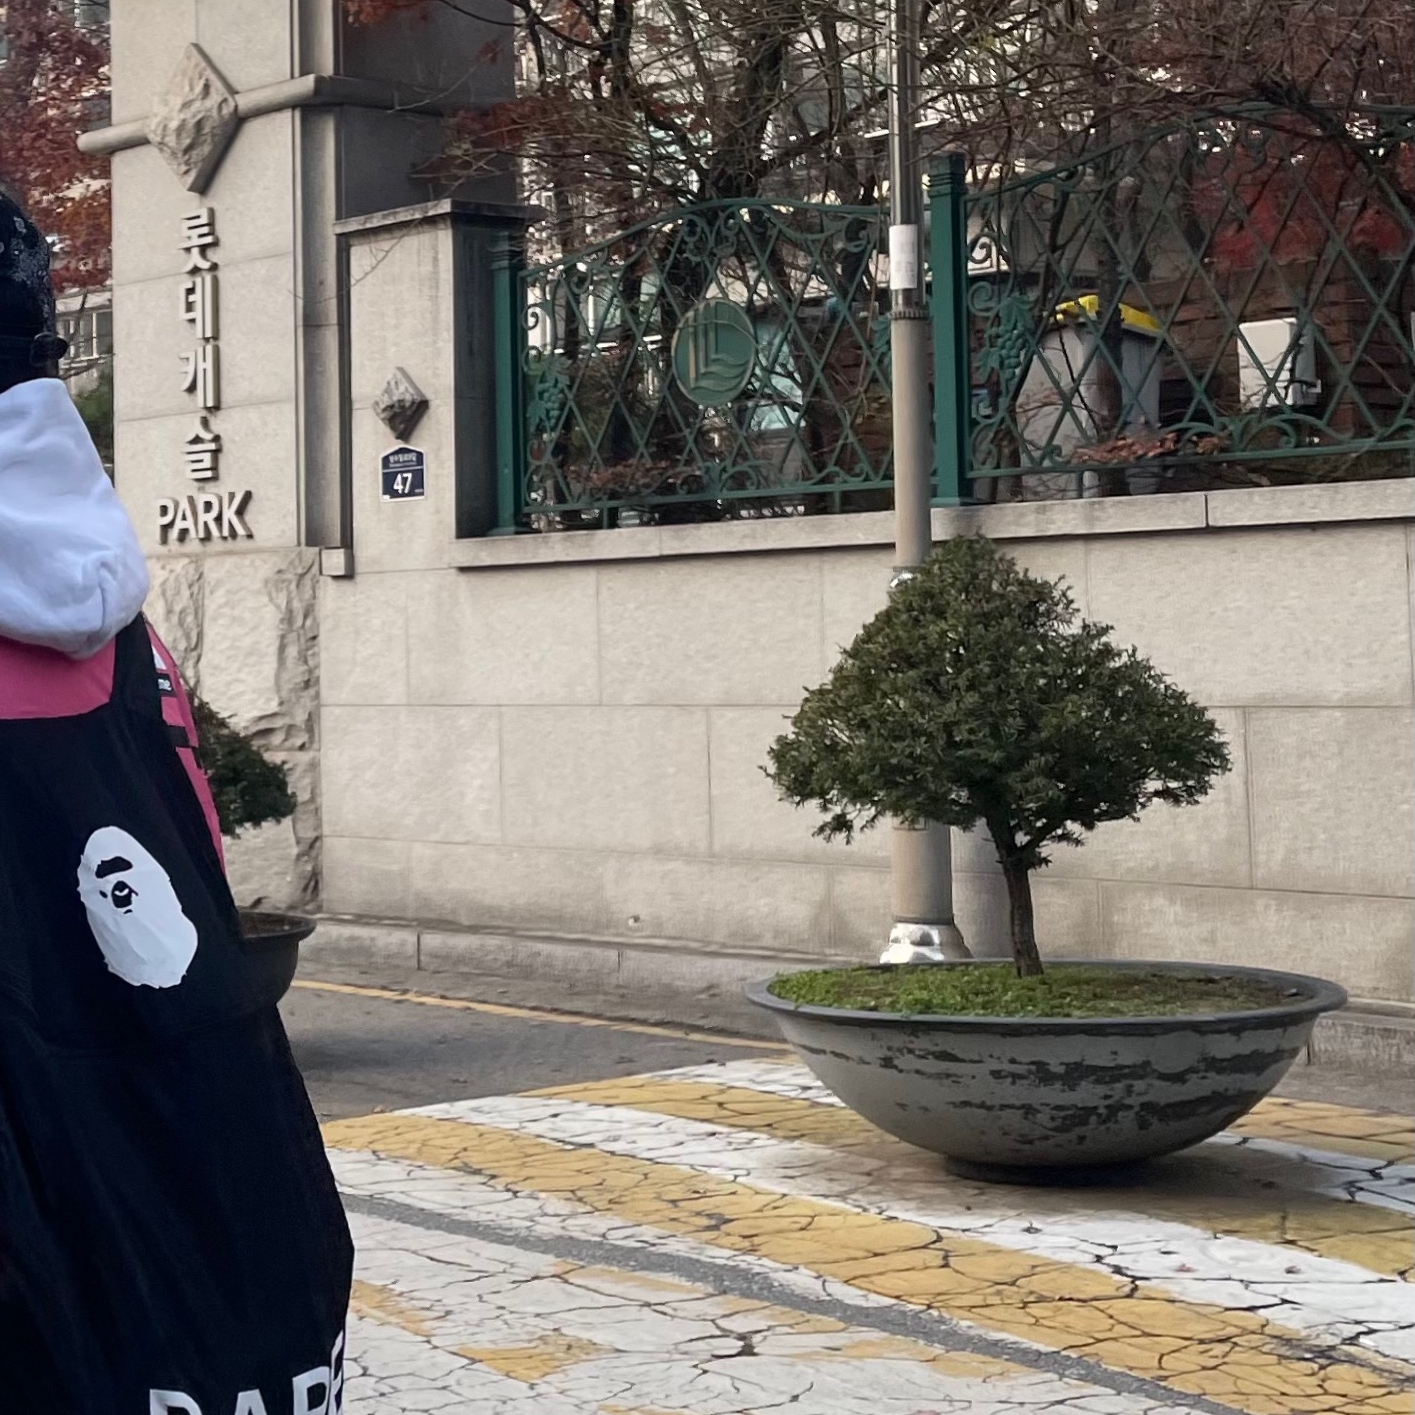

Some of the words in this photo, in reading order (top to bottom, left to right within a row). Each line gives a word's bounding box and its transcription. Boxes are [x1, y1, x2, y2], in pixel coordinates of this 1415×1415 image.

[178, 206, 222, 481] 롯데캐슬
[393, 472, 413, 494] 47
[158, 490, 254, 545] PARK
